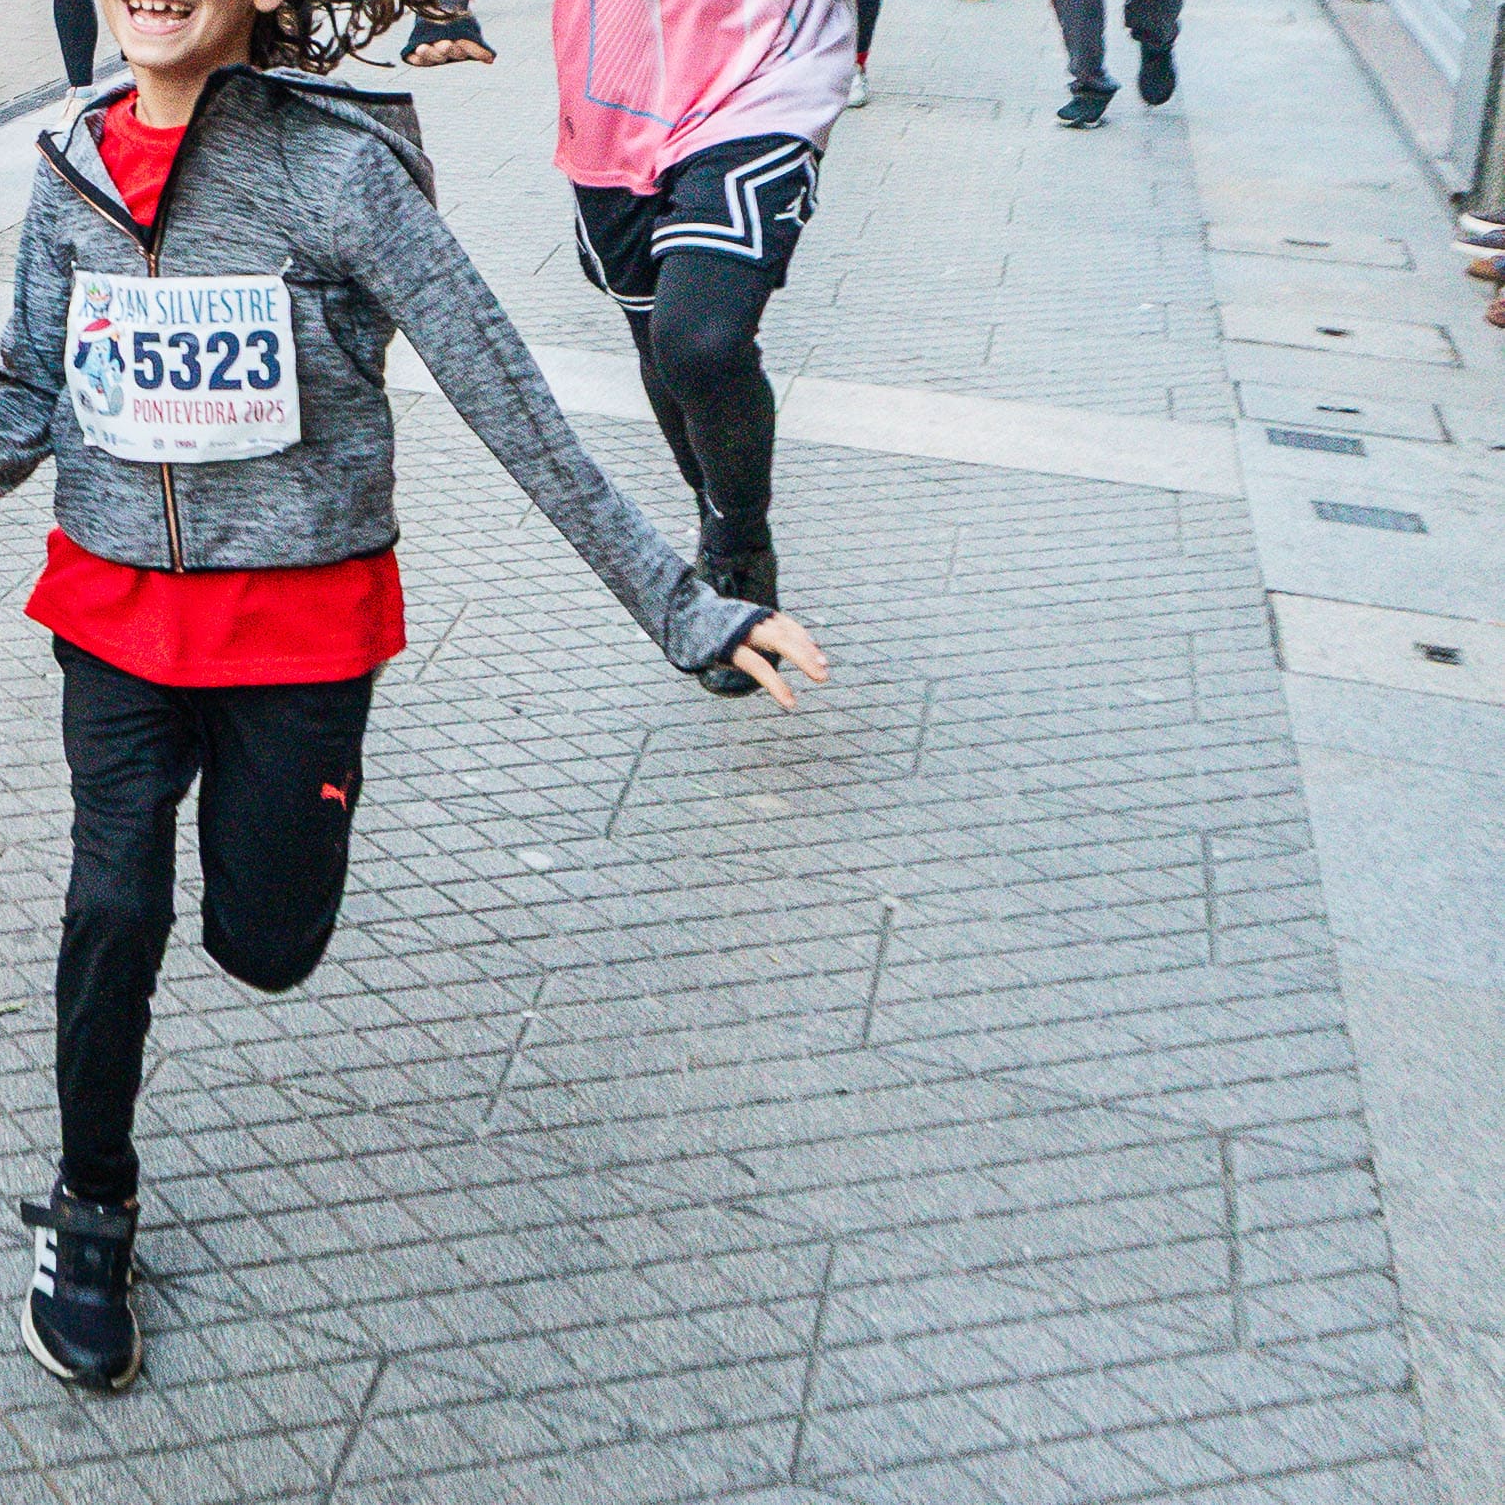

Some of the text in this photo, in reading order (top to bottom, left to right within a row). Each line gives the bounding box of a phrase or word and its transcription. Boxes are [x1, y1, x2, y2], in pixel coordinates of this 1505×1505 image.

[115, 285, 150, 324] SAN
[154, 285, 280, 326] SILVESTRE
[133, 329, 282, 392] 5323
[132, 397, 287, 426] PONTEVEDRA 2025
